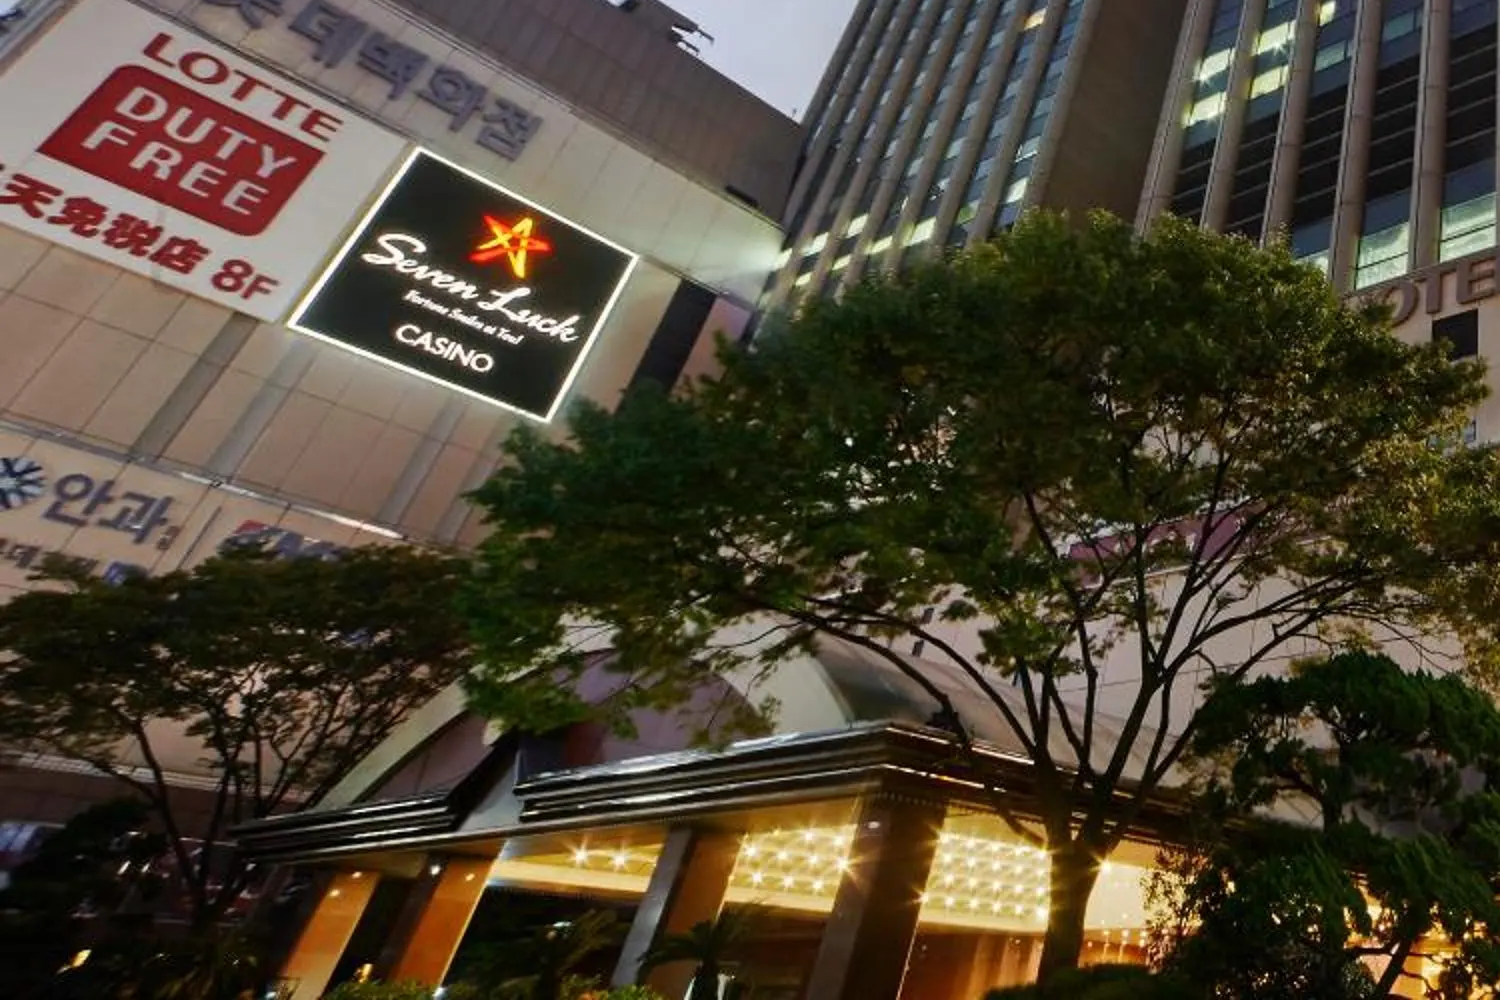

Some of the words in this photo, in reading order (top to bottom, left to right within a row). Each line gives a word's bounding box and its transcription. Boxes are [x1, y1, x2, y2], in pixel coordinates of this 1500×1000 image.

[114, 86, 297, 179] DUTY
[143, 32, 344, 143] LOTTE
[81, 121, 270, 216] FREE
[0, 164, 212, 276] 天免税店
[211, 259, 280, 299] 8F
[361, 233, 480, 300] Seven
[476, 286, 580, 343] Luck
[395, 323, 495, 372] CASINO
[42, 473, 175, 545] 안과
